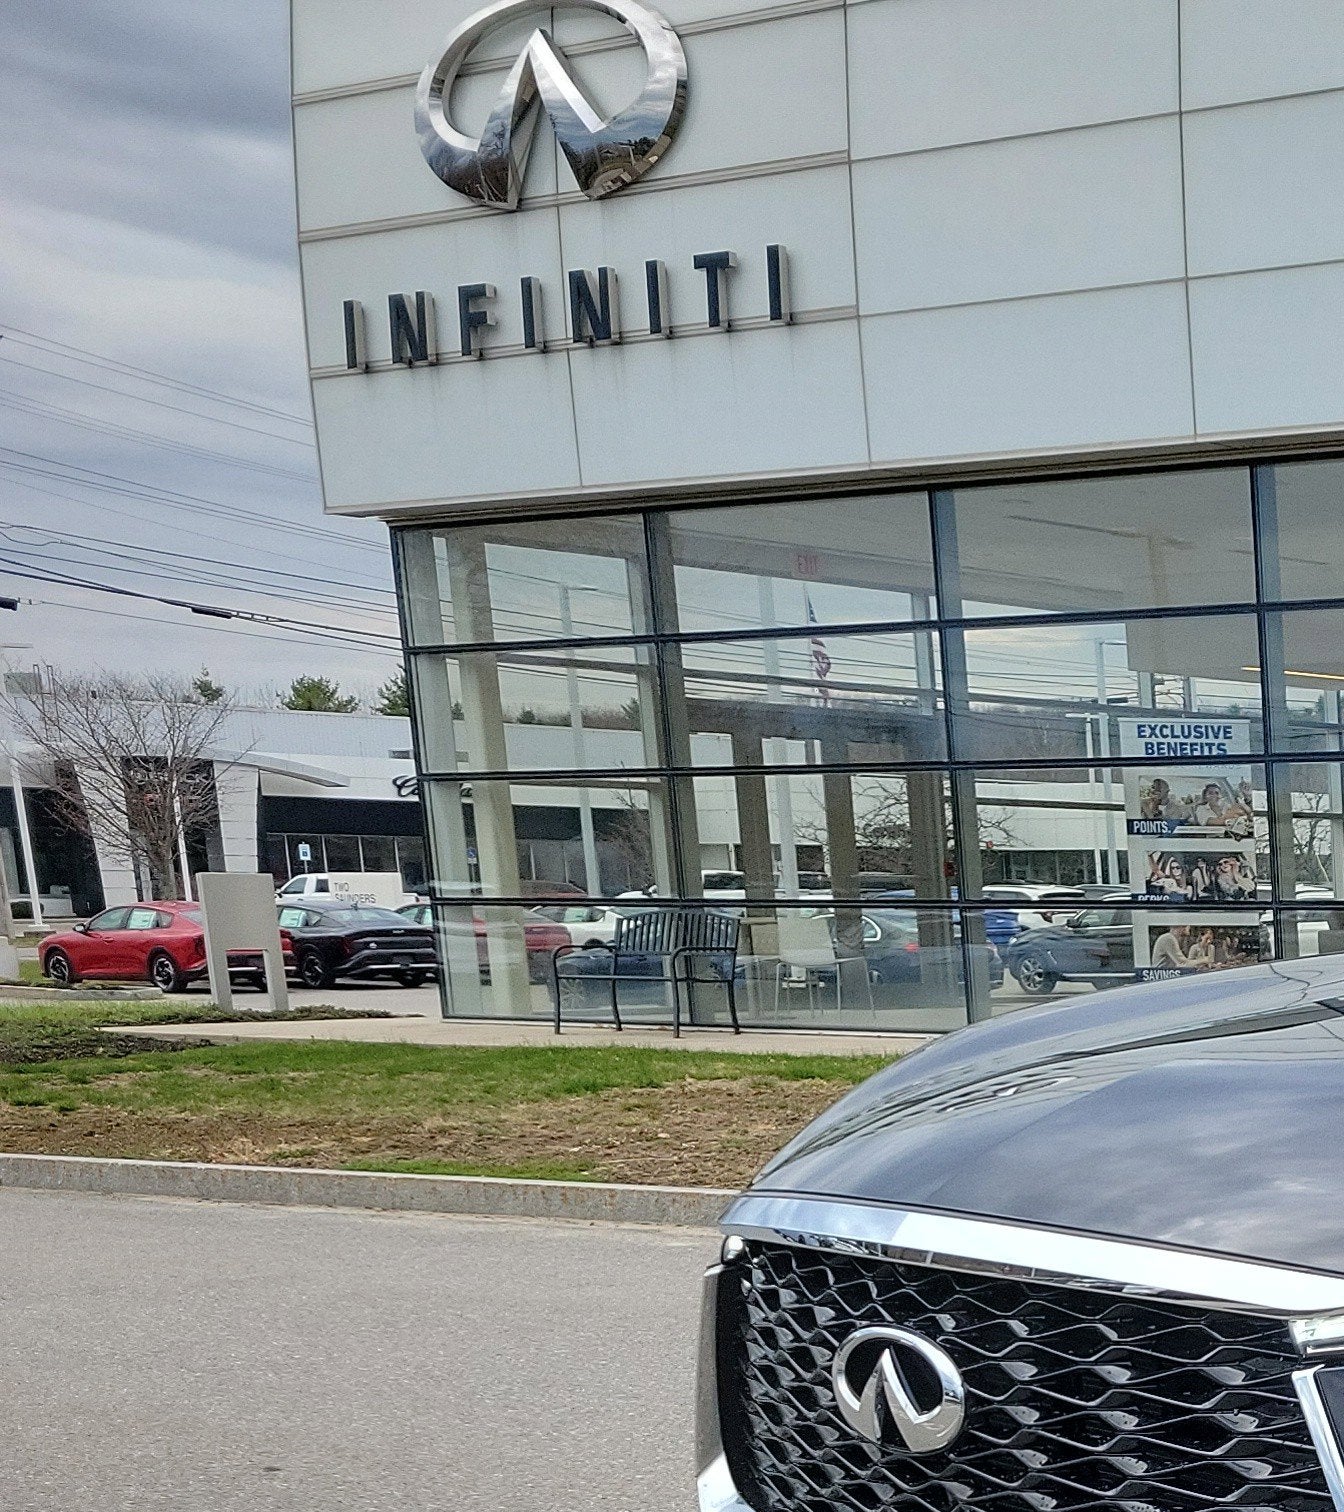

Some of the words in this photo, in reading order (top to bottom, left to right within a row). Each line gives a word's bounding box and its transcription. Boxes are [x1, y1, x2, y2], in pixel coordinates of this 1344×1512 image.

[342, 243, 791, 372] INFINITI
[1137, 724, 1233, 739] EXCLUSIVE
[1144, 741, 1228, 756] BENEFITS
[1133, 820, 1172, 834] POINTS.
